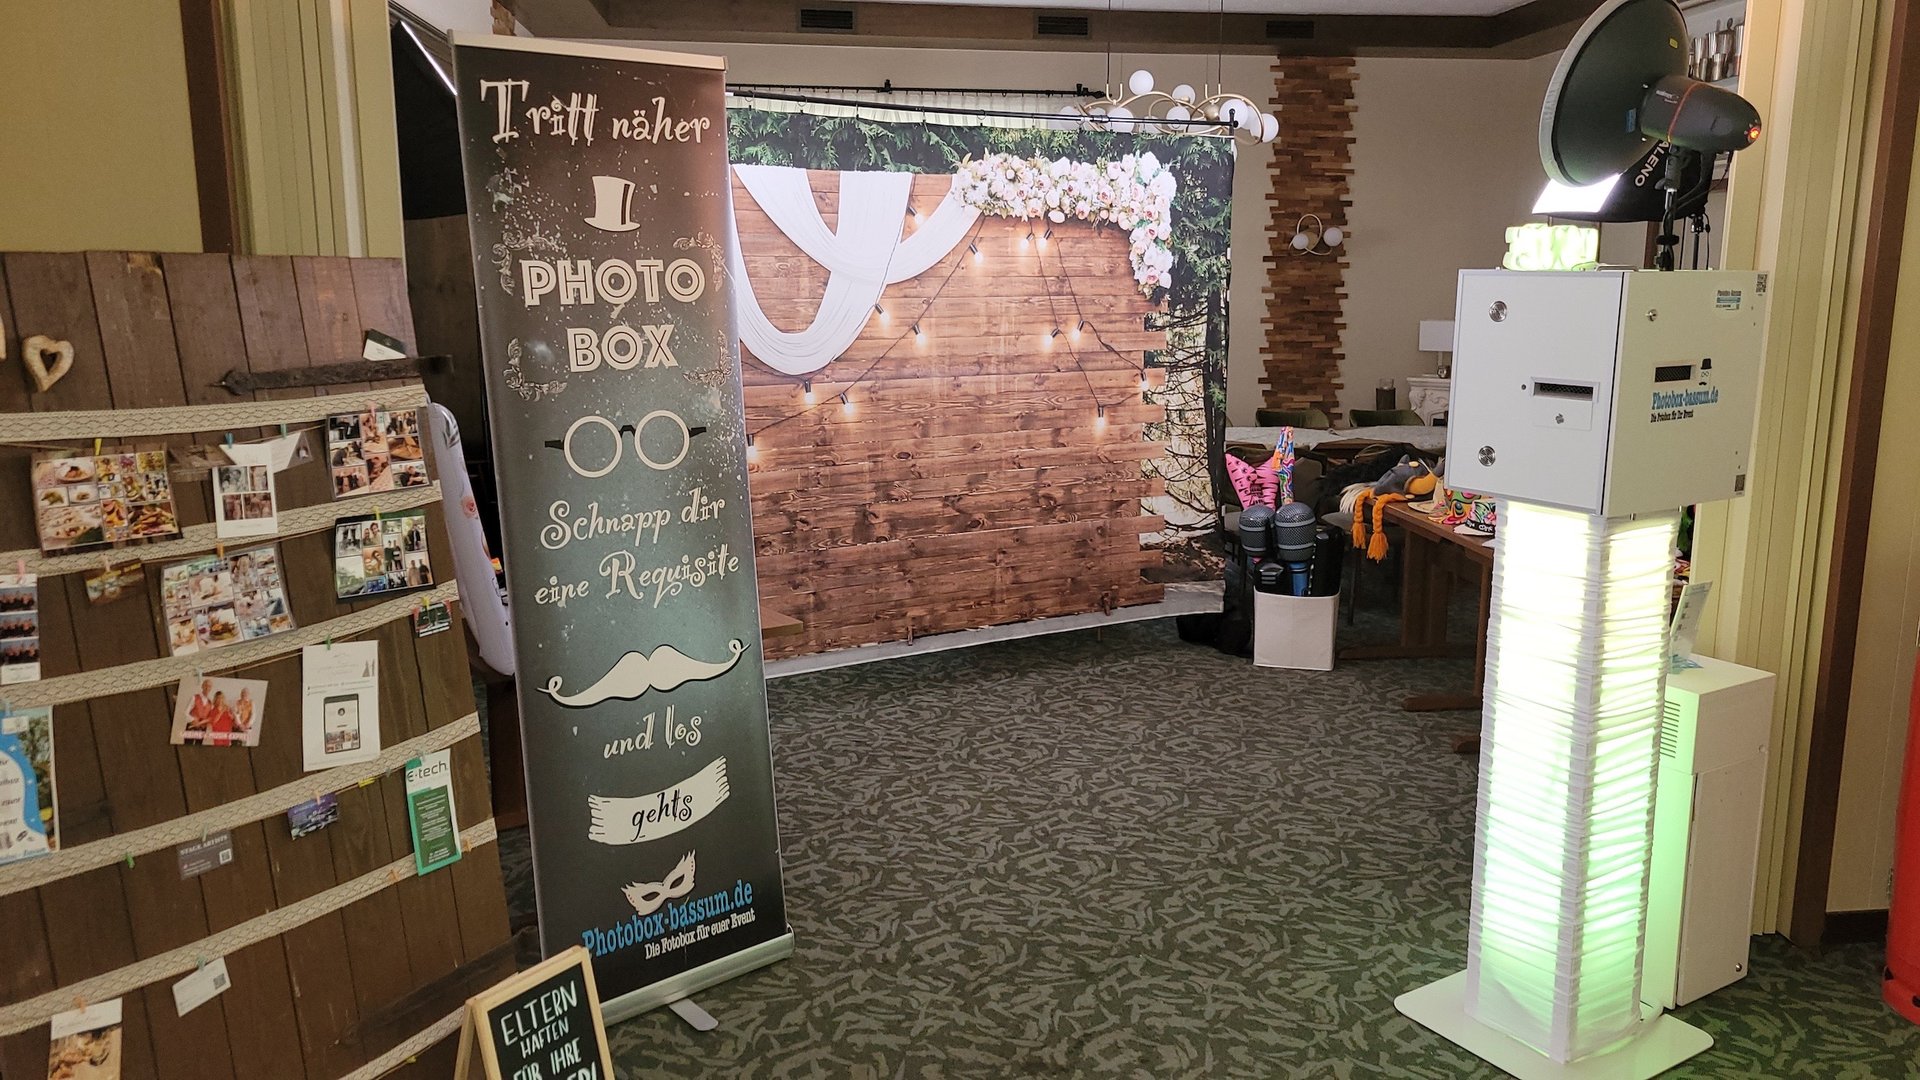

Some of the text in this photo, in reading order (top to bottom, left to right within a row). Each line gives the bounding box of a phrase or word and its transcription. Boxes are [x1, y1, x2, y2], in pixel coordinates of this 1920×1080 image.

[479, 78, 711, 146] Tritt näher
[519, 257, 706, 307] PHOTO
[566, 323, 679, 373] BOX
[540, 487, 726, 550] Schnapp dir
[534, 543, 740, 609] eine Requisite
[603, 704, 702, 759] und los
[630, 788, 693, 842] gehts
[581, 878, 753, 958] Photobox-bassum.de
[644, 907, 756, 960] Die Fotobox für euer Event
[500, 980, 578, 1046] ELTERN
[520, 1016, 569, 1059] HAFTEN
[550, 1037, 582, 1075] IHRE
